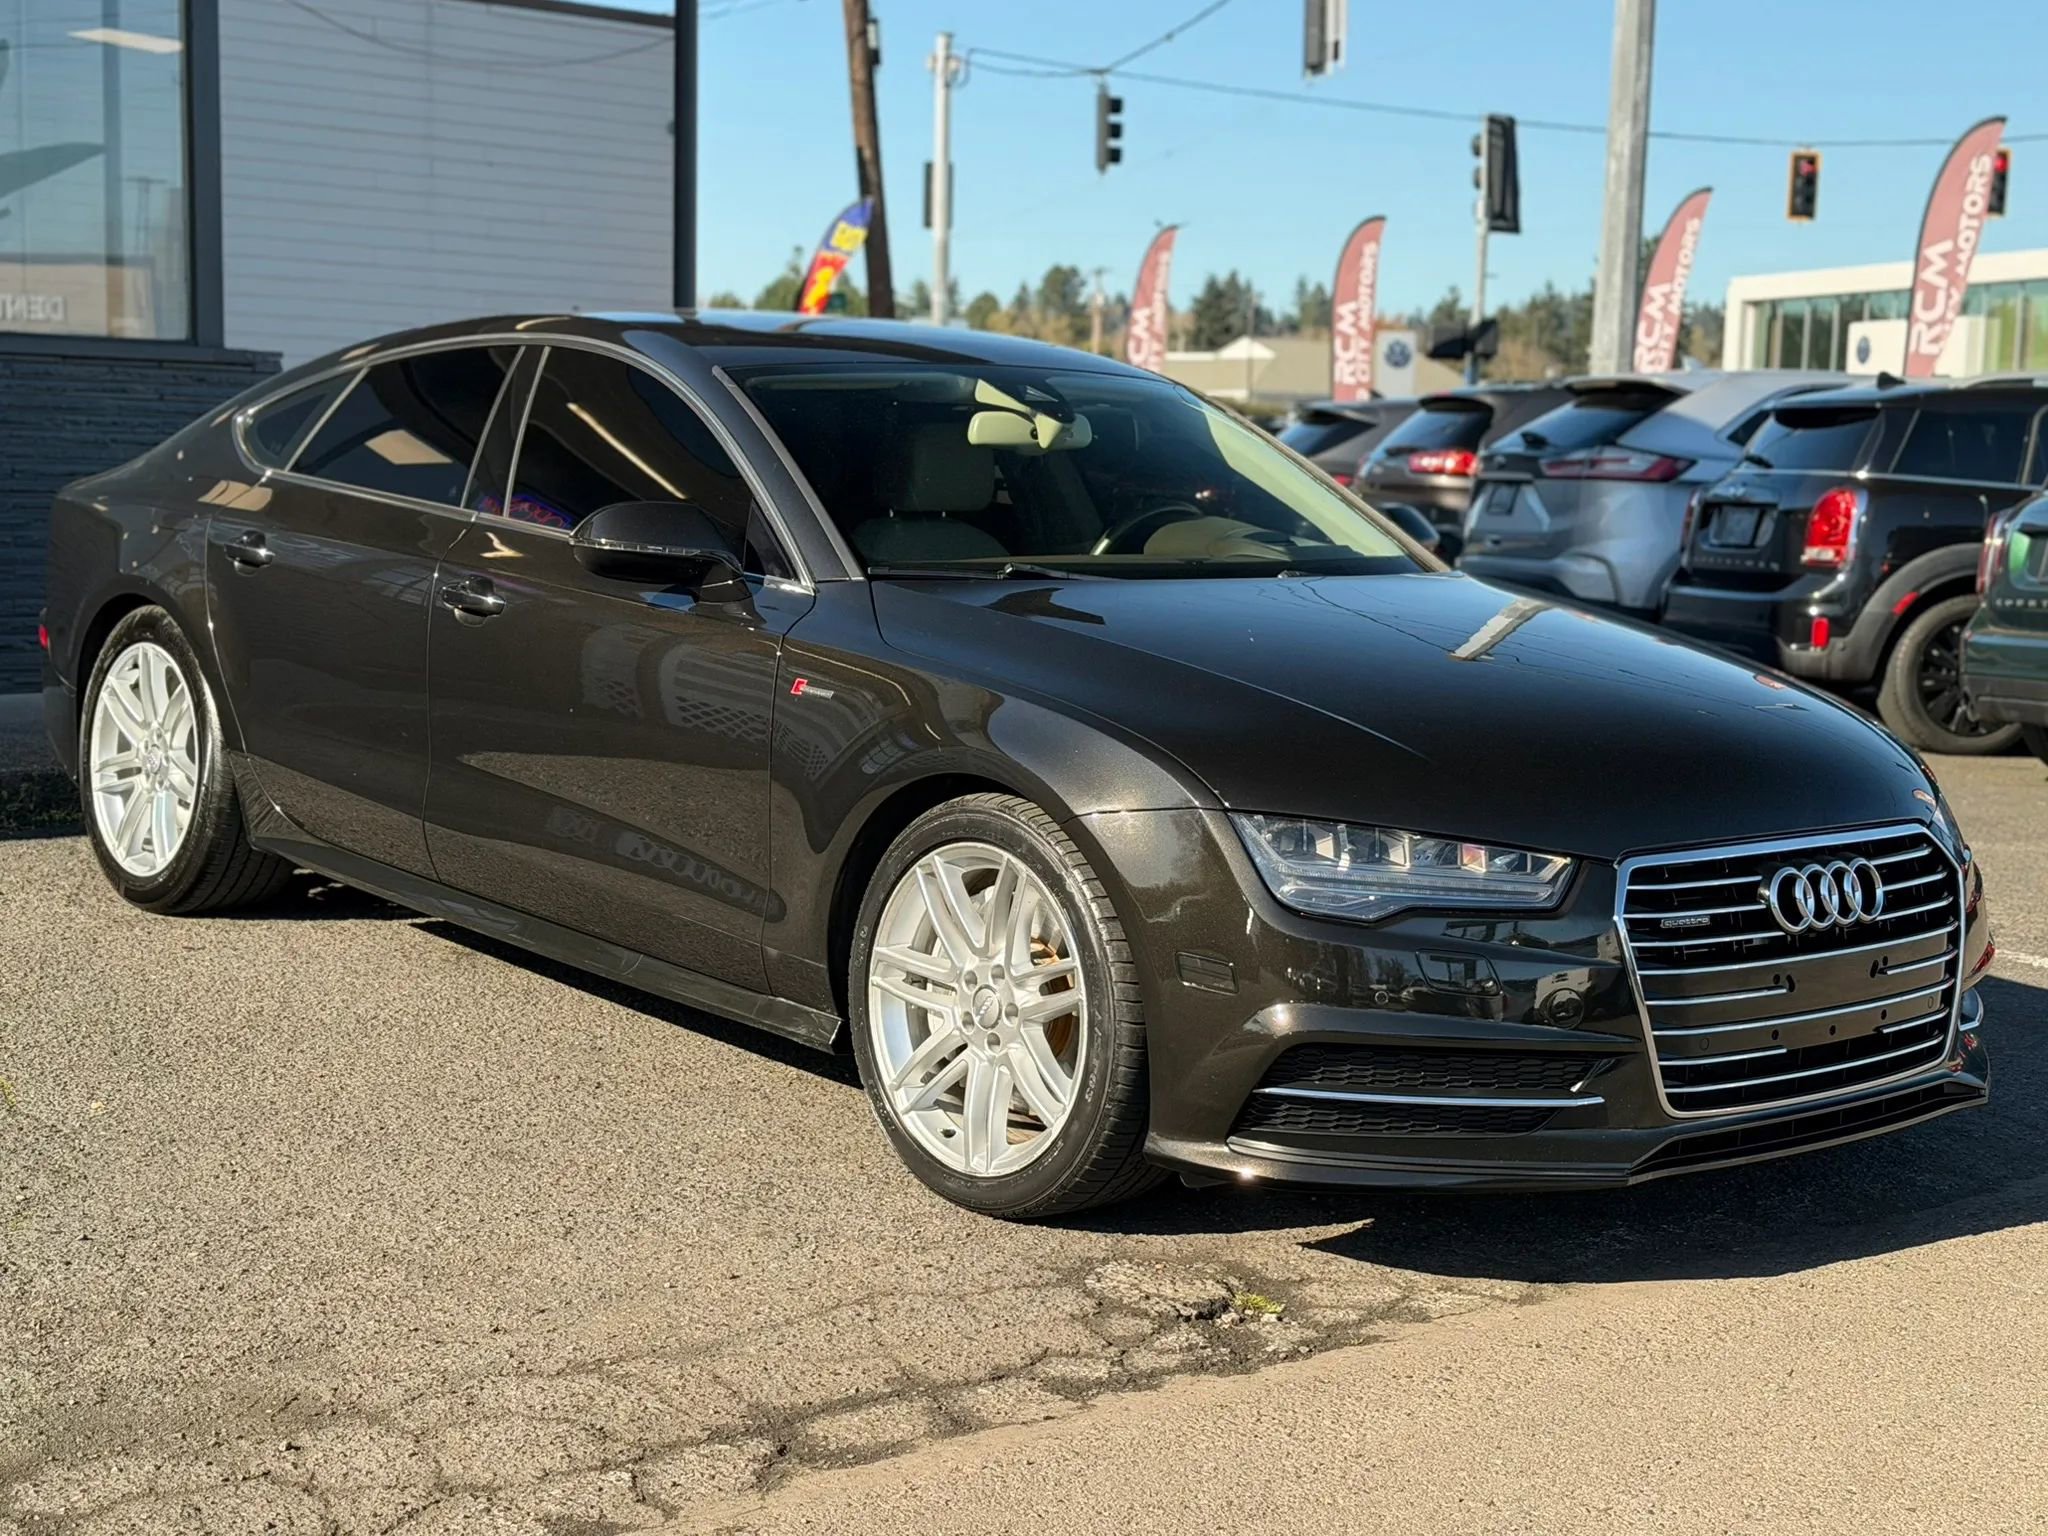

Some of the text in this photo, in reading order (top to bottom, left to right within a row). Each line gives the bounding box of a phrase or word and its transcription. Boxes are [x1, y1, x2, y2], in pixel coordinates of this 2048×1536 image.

[1956, 154, 1991, 275] MOTORS
[1357, 242, 1378, 332] MOTORS
[1668, 217, 1700, 315] MOTORS
[1909, 238, 1954, 356] RCM
[1128, 307, 1152, 366] CM
[1334, 302, 1358, 384] RCM
[1664, 917, 1710, 928] quattro
